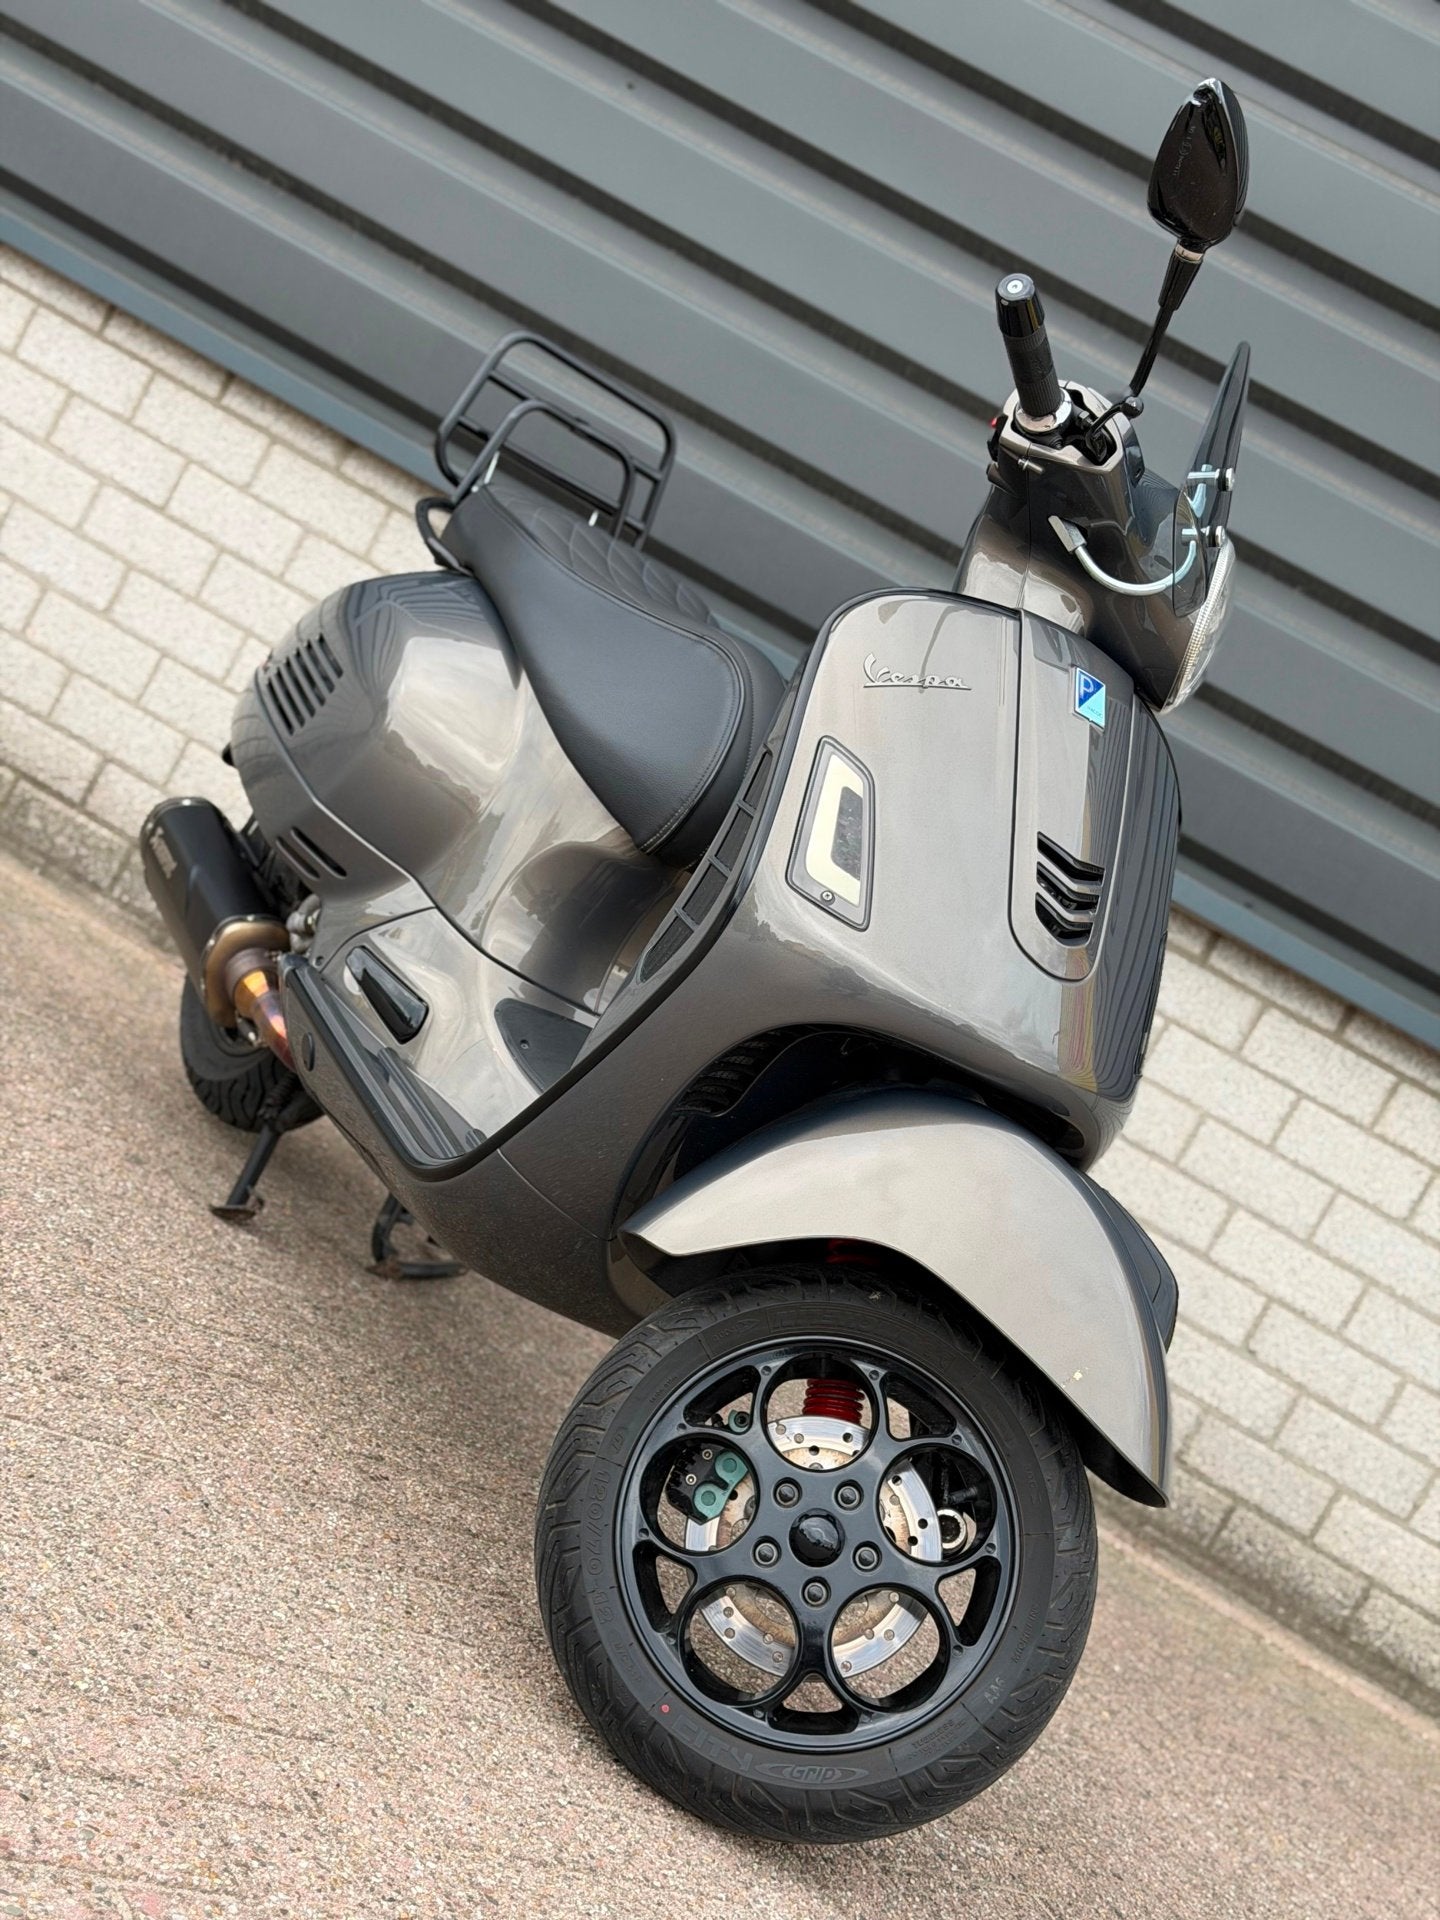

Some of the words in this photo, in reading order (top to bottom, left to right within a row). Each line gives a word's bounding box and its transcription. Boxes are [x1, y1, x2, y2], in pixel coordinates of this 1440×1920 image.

[863, 653, 971, 691] Vespa
[1079, 673, 1095, 699] P
[789, 1765, 837, 1782] GRIP
